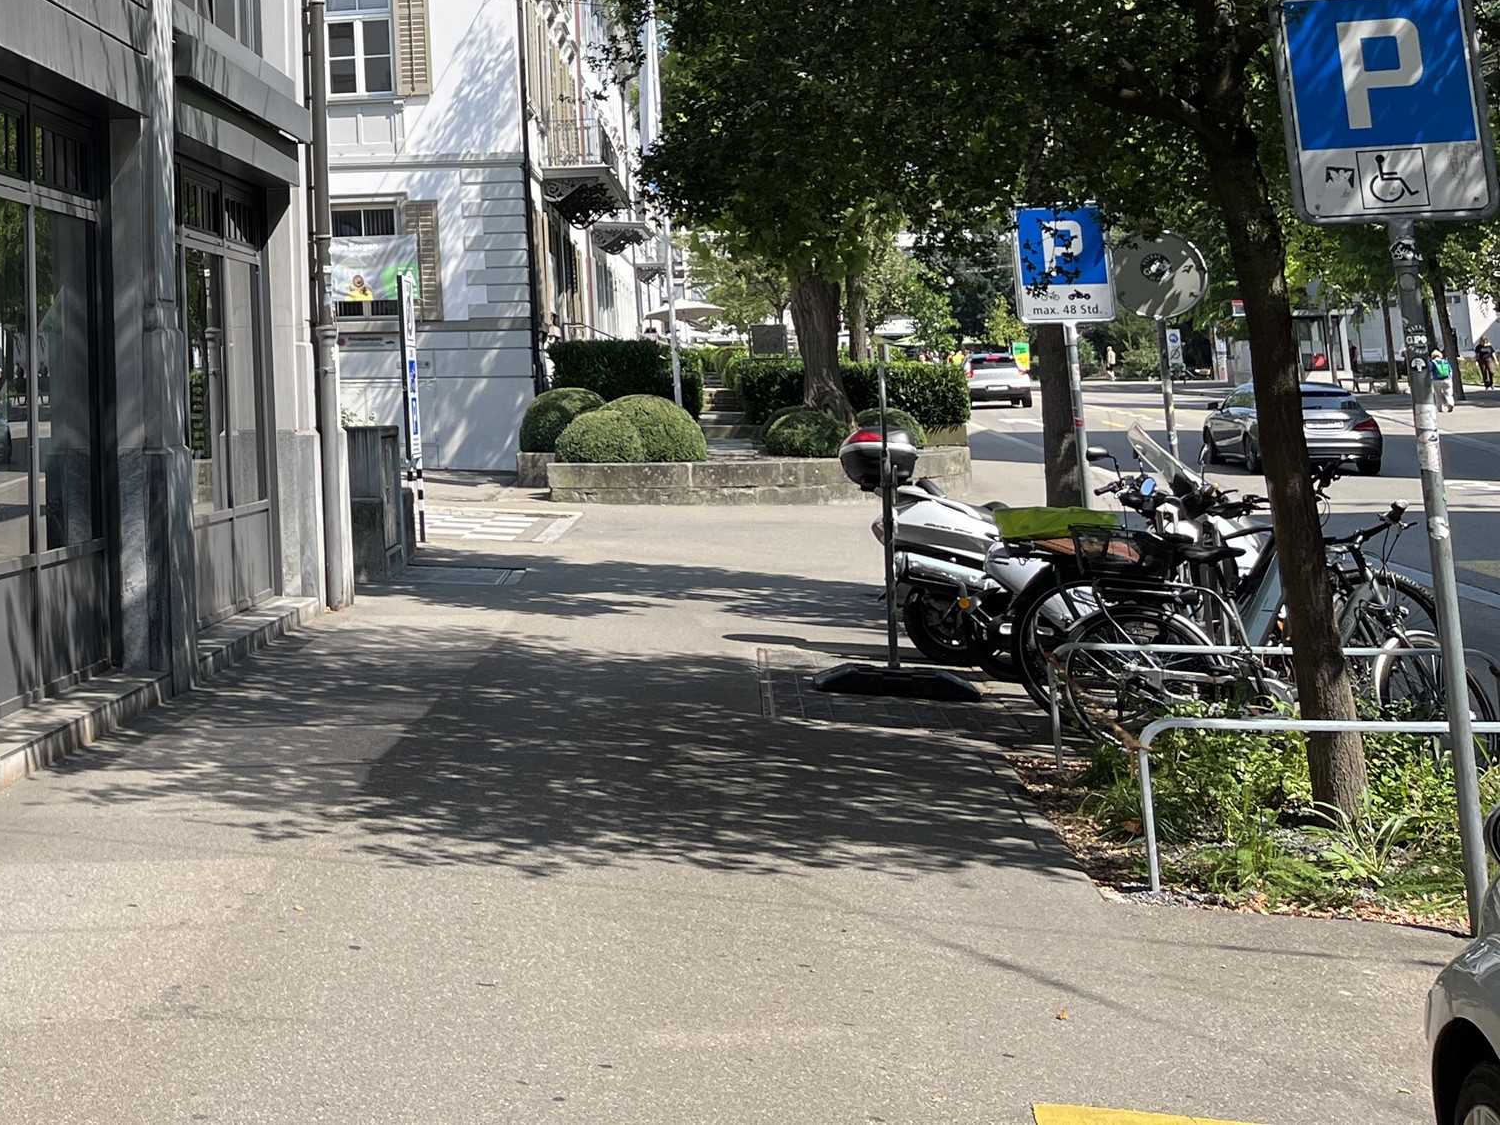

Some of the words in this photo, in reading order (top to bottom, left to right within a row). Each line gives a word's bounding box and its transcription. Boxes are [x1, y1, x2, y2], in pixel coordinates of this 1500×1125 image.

[1336, 17, 1424, 130] P
[1041, 220, 1085, 277] P
[1033, 307, 1060, 315] max.
[1062, 304, 1077, 315] 48
[1081, 304, 1104, 314] Std.
